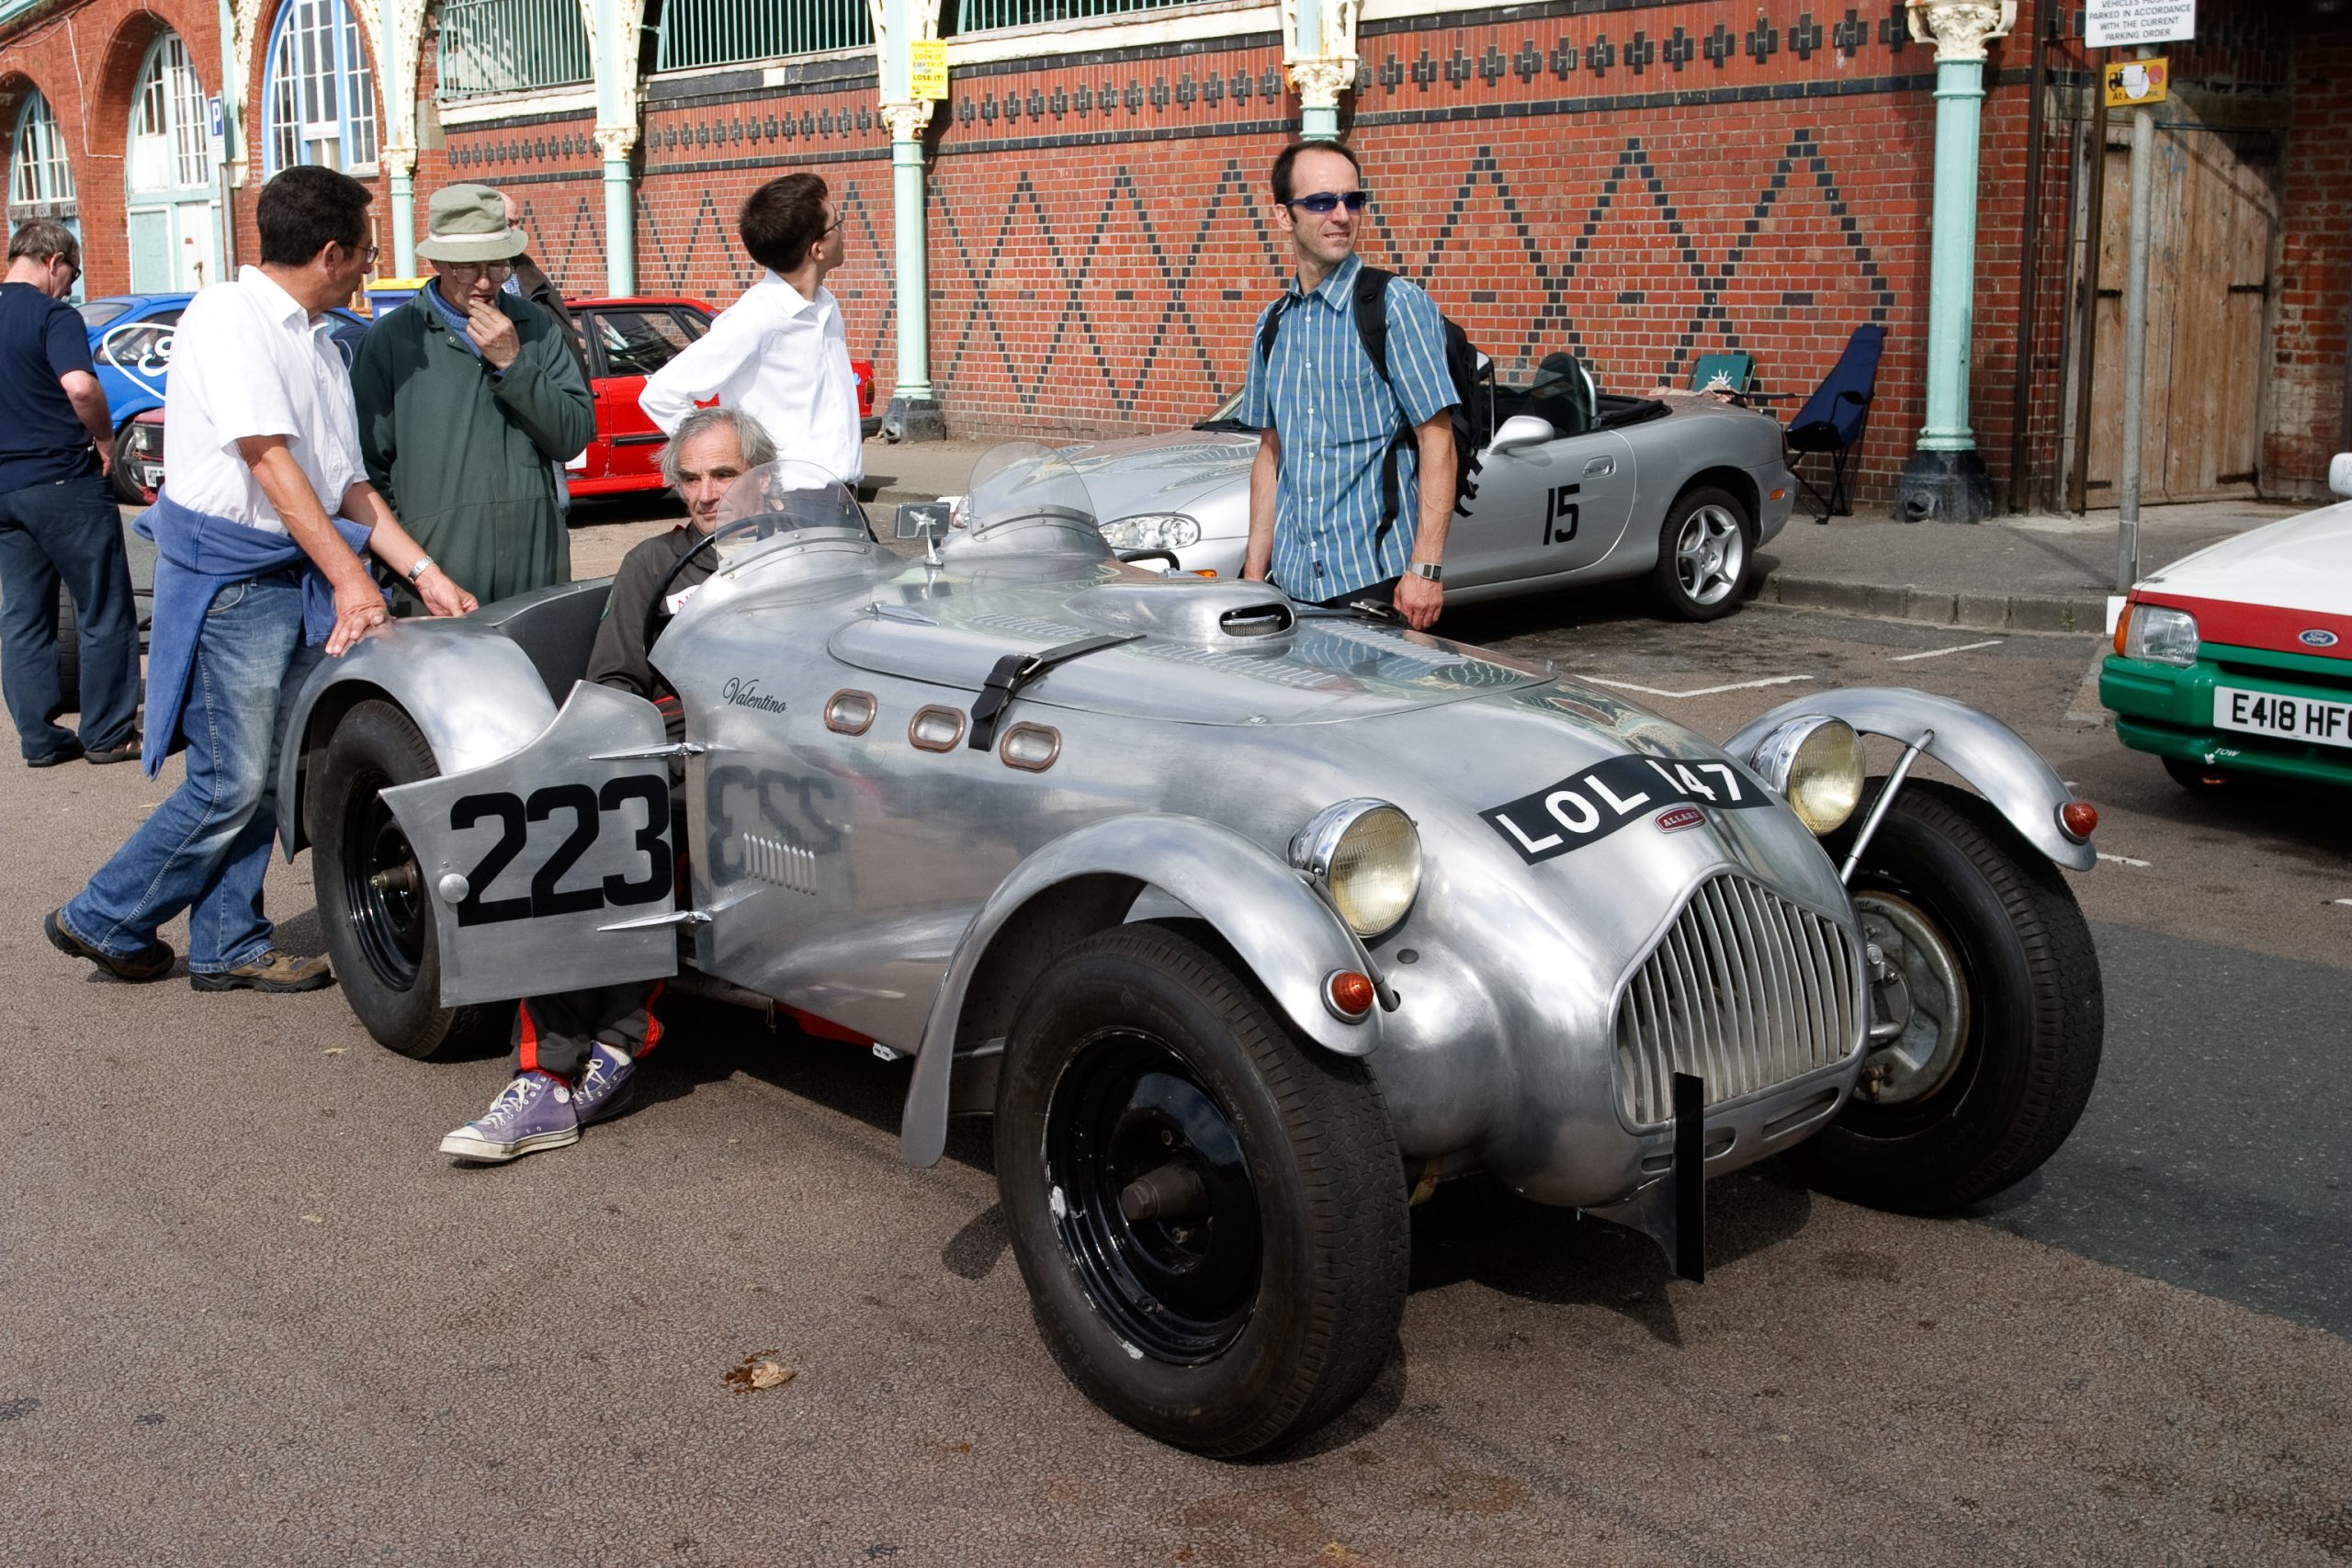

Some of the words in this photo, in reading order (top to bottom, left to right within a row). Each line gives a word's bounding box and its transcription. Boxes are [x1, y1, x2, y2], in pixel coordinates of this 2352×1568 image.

[2089, 11, 2120, 19] PARKED
[2134, 4, 2191, 17] ACCORDANCE
[2100, 22, 2120, 30] WITH
[2122, 20, 2137, 28] THE
[2141, 17, 2179, 28] CURRENT
[2105, 30, 2140, 40] PARKING
[211, 102, 221, 135] P
[1544, 483, 1580, 547] 15
[722, 677, 787, 714] Valentino
[2232, 693, 2296, 732] E418
[2305, 704, 2352, 740] HF
[1495, 774, 1650, 854] LOL
[1645, 759, 1742, 801] 147
[449, 774, 673, 928] 223
